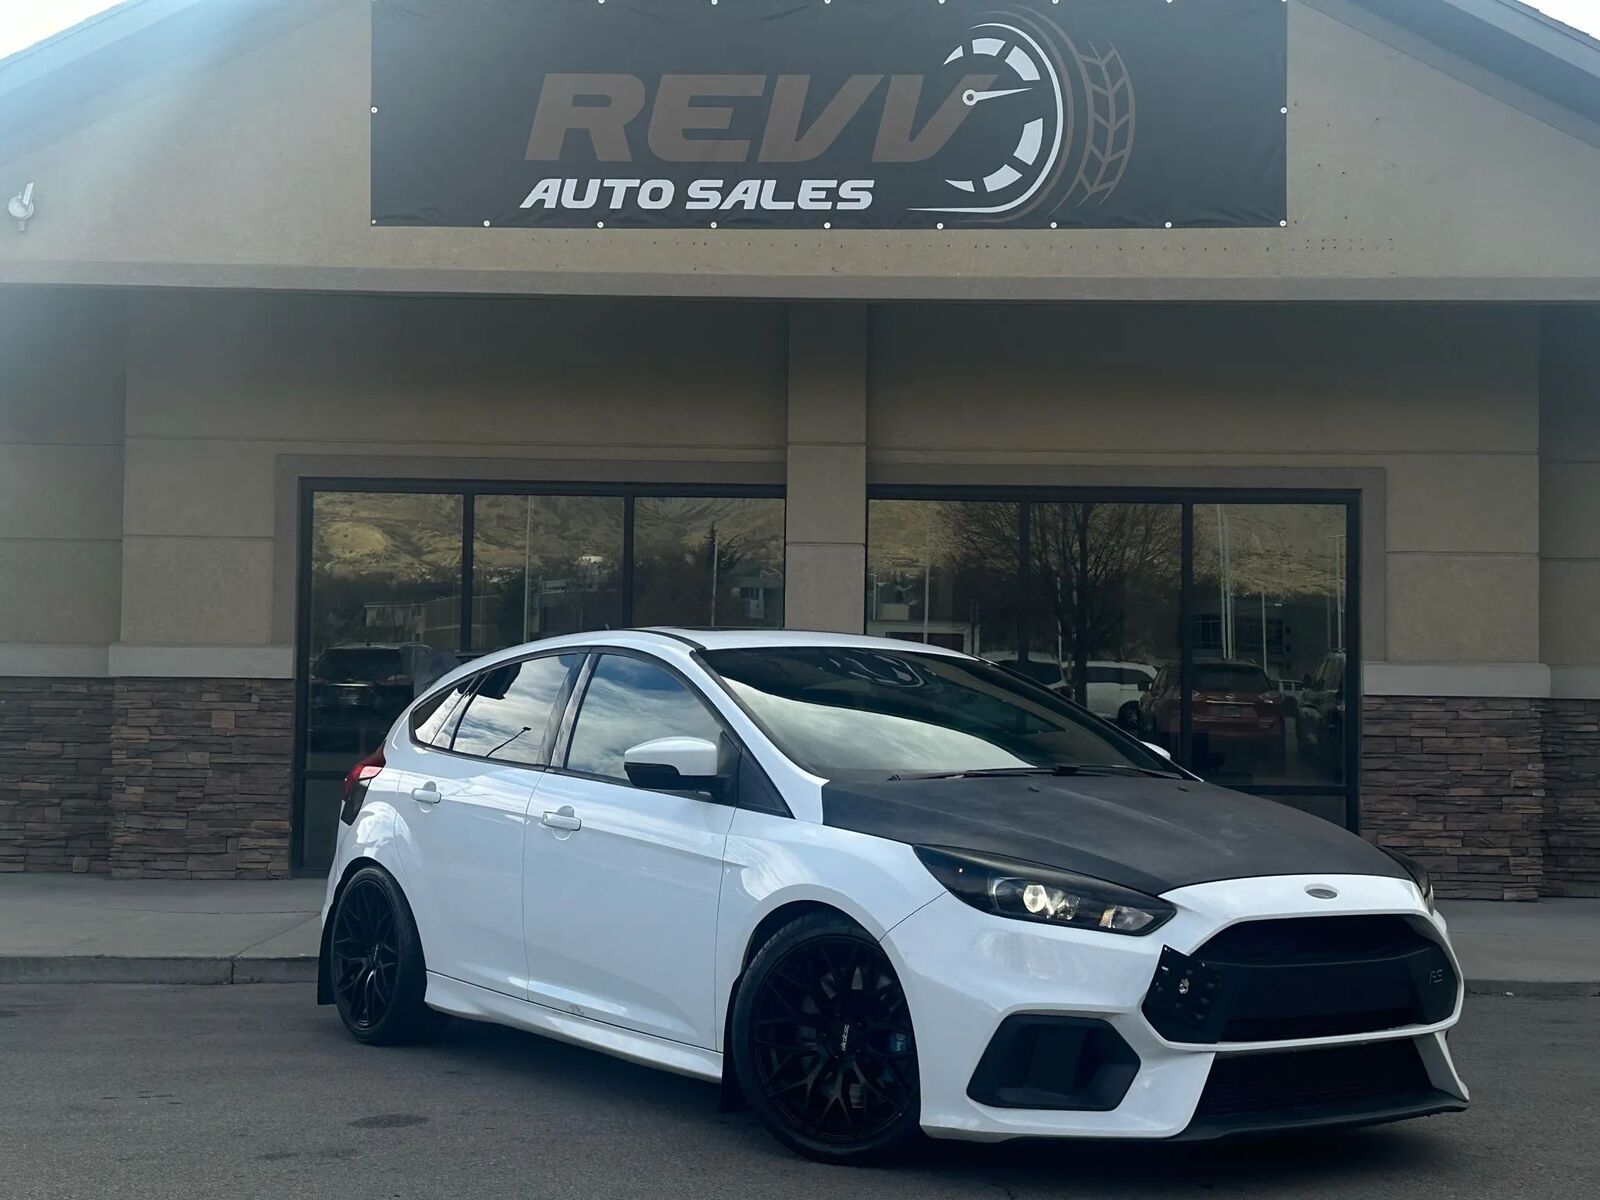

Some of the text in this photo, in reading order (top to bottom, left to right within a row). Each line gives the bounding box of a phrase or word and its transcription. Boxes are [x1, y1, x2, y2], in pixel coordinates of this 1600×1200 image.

[524, 72, 998, 163] REVV
[519, 178, 875, 211] AUTO SALES
